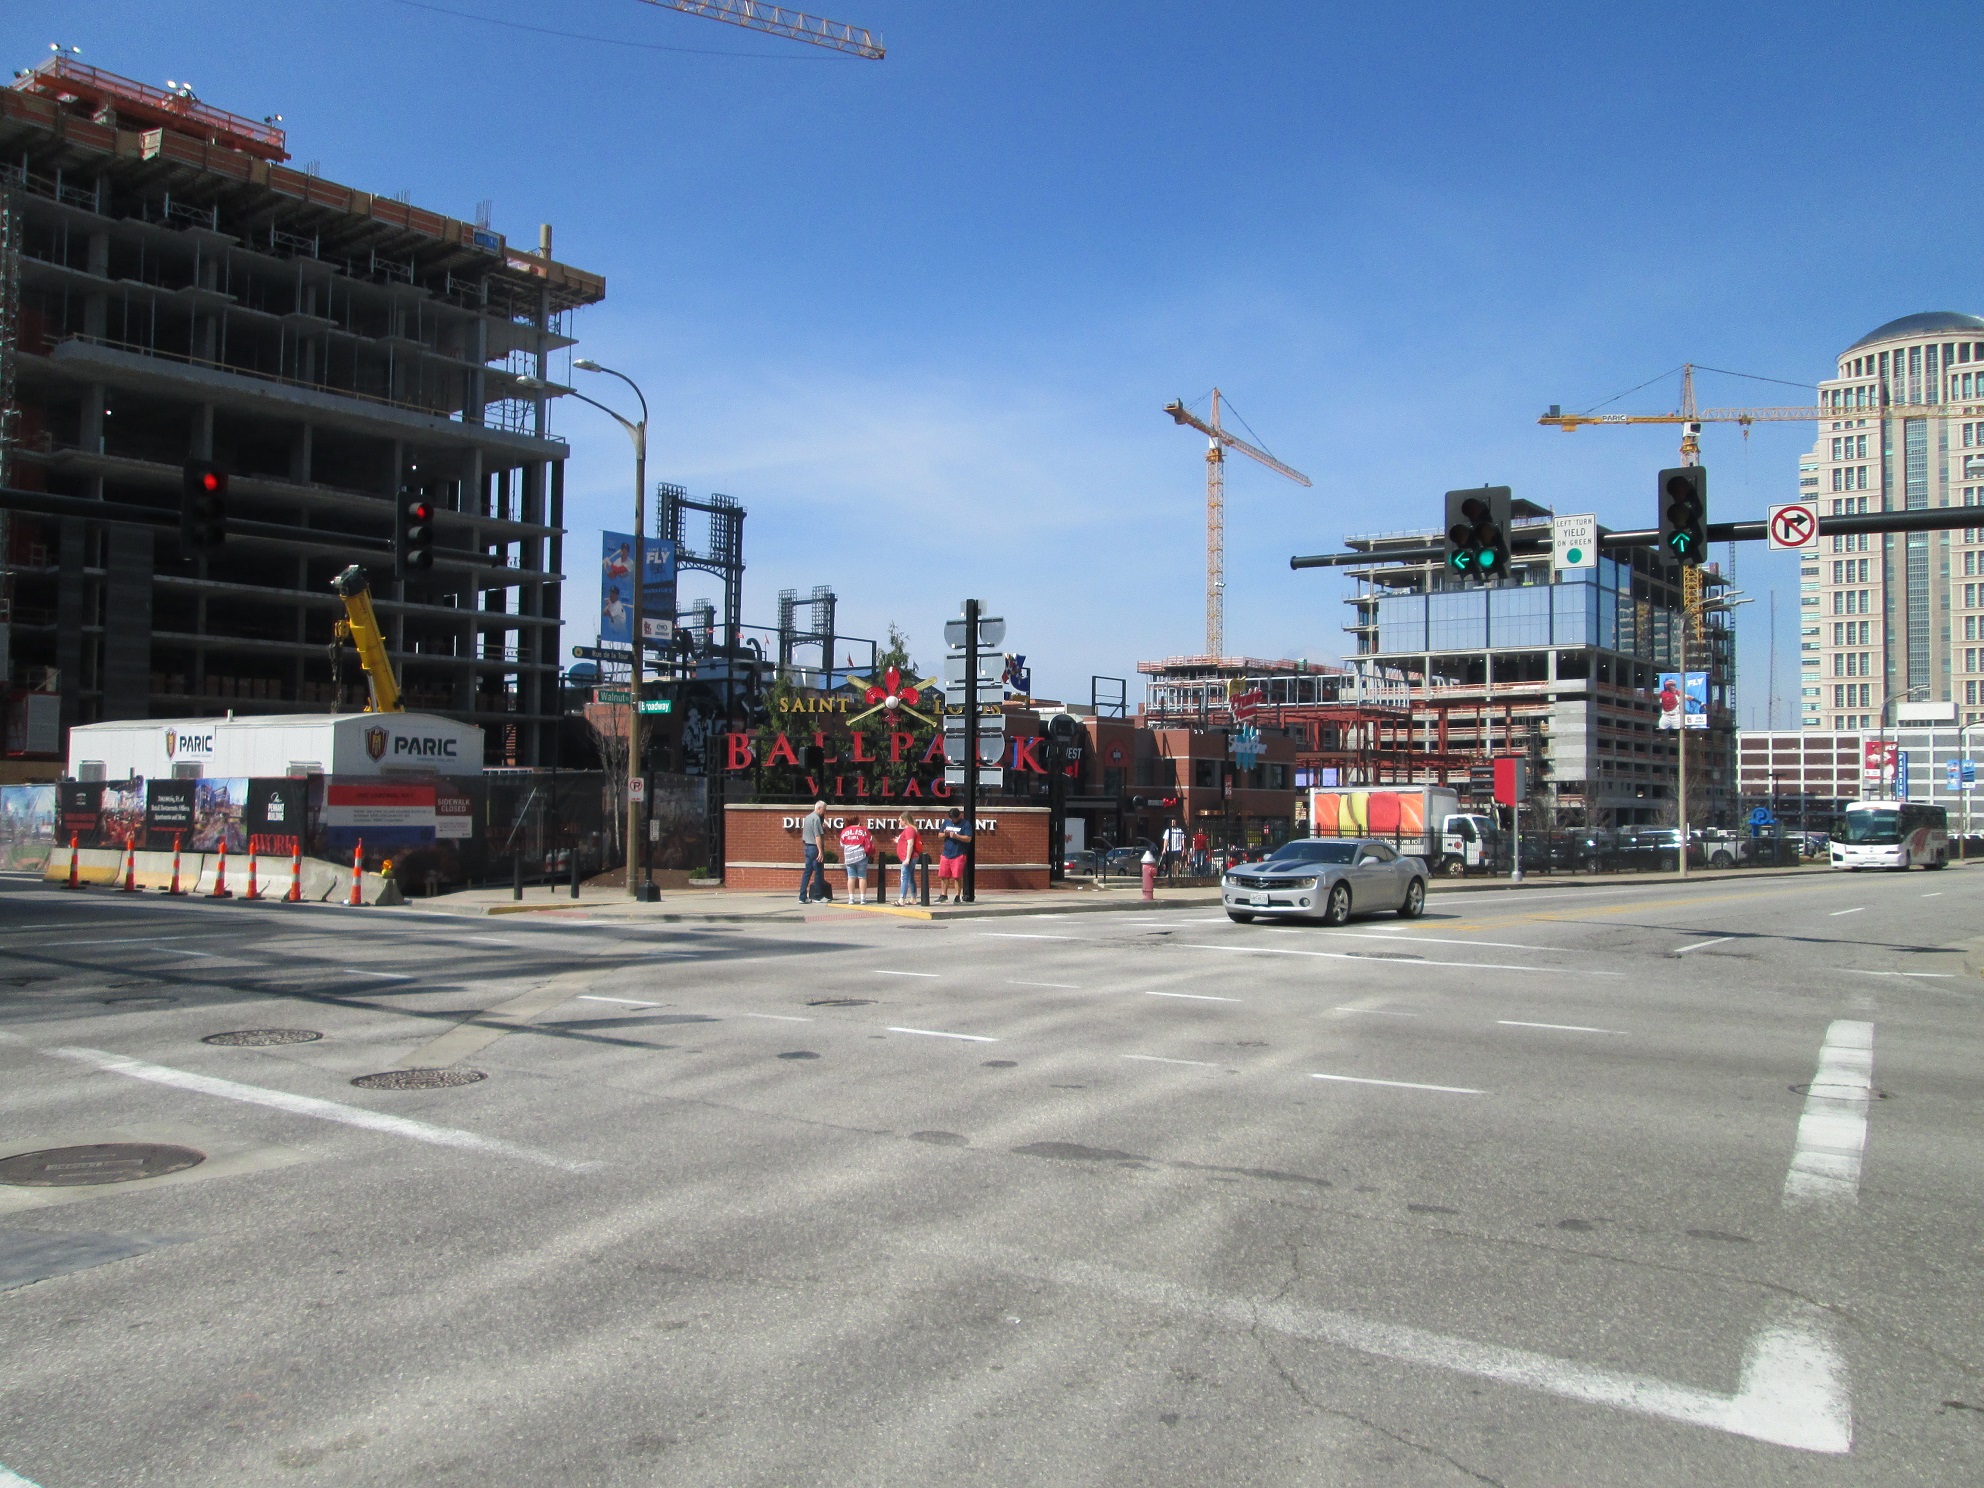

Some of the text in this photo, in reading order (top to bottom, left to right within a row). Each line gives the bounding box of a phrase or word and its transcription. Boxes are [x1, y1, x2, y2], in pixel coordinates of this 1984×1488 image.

[1556, 518, 1592, 528] LEFT TURN
[1564, 528, 1586, 537] YIELD
[646, 551, 670, 564] FLY
[1687, 678, 1704, 687] FLY
[600, 692, 625, 701] Walnut
[641, 701, 670, 712] Broadway
[780, 697, 849, 713] SAINT
[179, 735, 213, 752] PARIC
[394, 736, 457, 756] PARIC
[725, 731, 1048, 774] BALLPAK
[805, 776, 952, 798] VILLAG
[783, 817, 844, 829] DING
[866, 818, 997, 830] ENTTAINT
